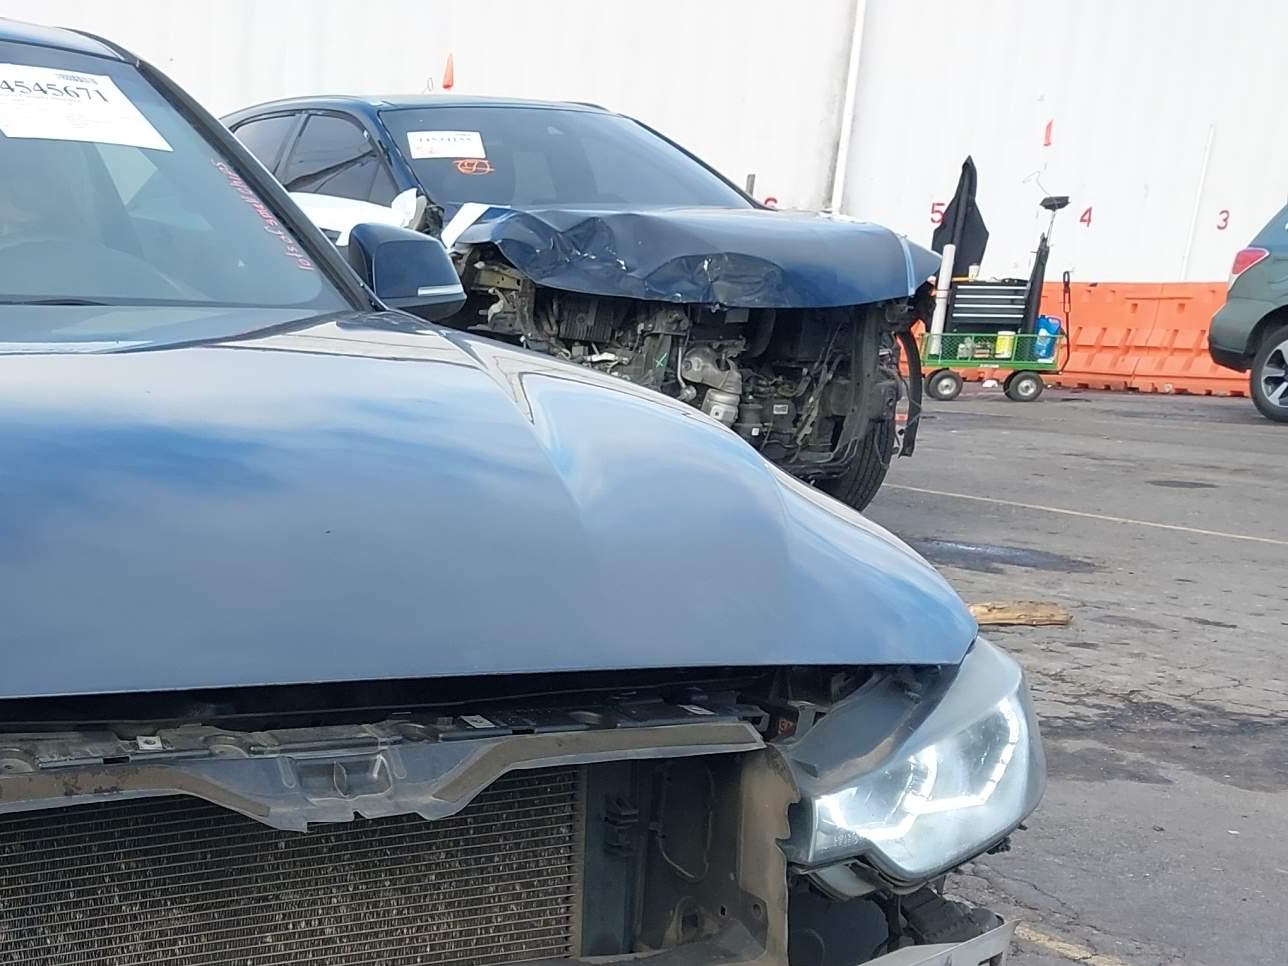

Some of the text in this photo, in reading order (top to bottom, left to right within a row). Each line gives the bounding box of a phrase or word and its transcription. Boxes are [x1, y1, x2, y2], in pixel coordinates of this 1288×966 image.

[929, 202, 946, 224] 5
[1078, 206, 1093, 229] 4
[1215, 209, 1230, 231] 3
